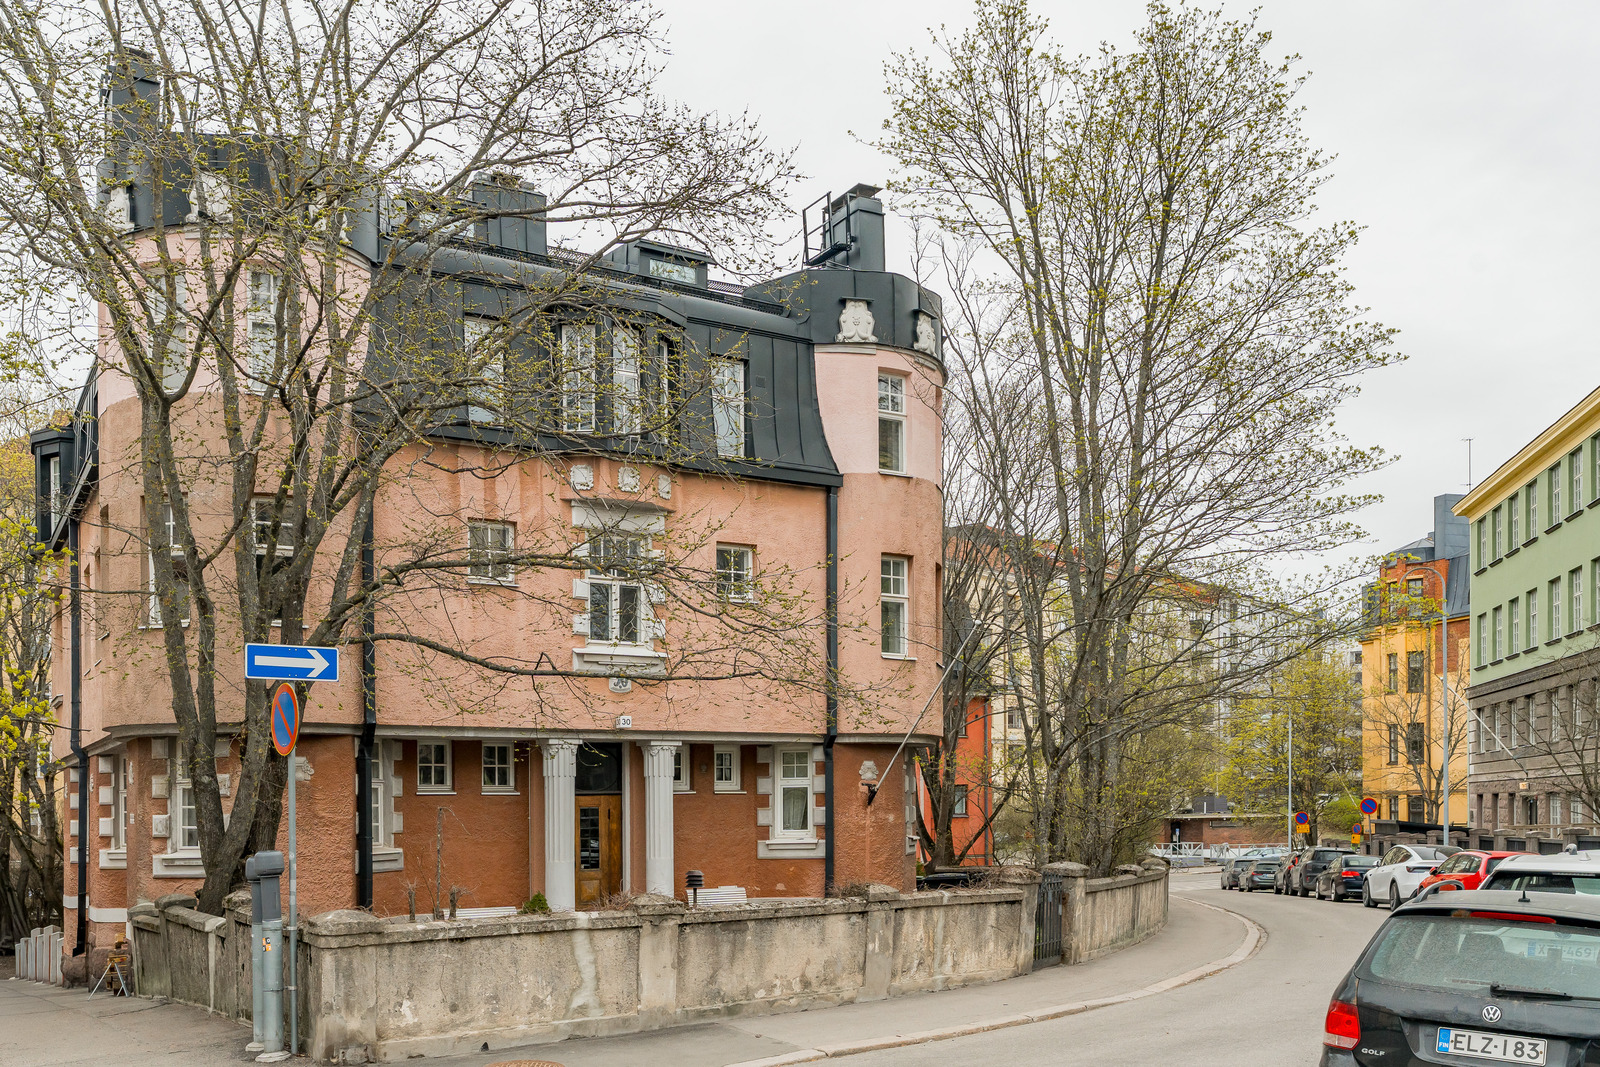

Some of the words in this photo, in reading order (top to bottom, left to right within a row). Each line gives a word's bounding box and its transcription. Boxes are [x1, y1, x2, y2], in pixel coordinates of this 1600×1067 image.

[621, 718, 631, 726] 30
[1538, 943, 1592, 958] X-469
[1361, 1047, 1386, 1057] GOLF
[1453, 1033, 1540, 1060] ELZ-183
